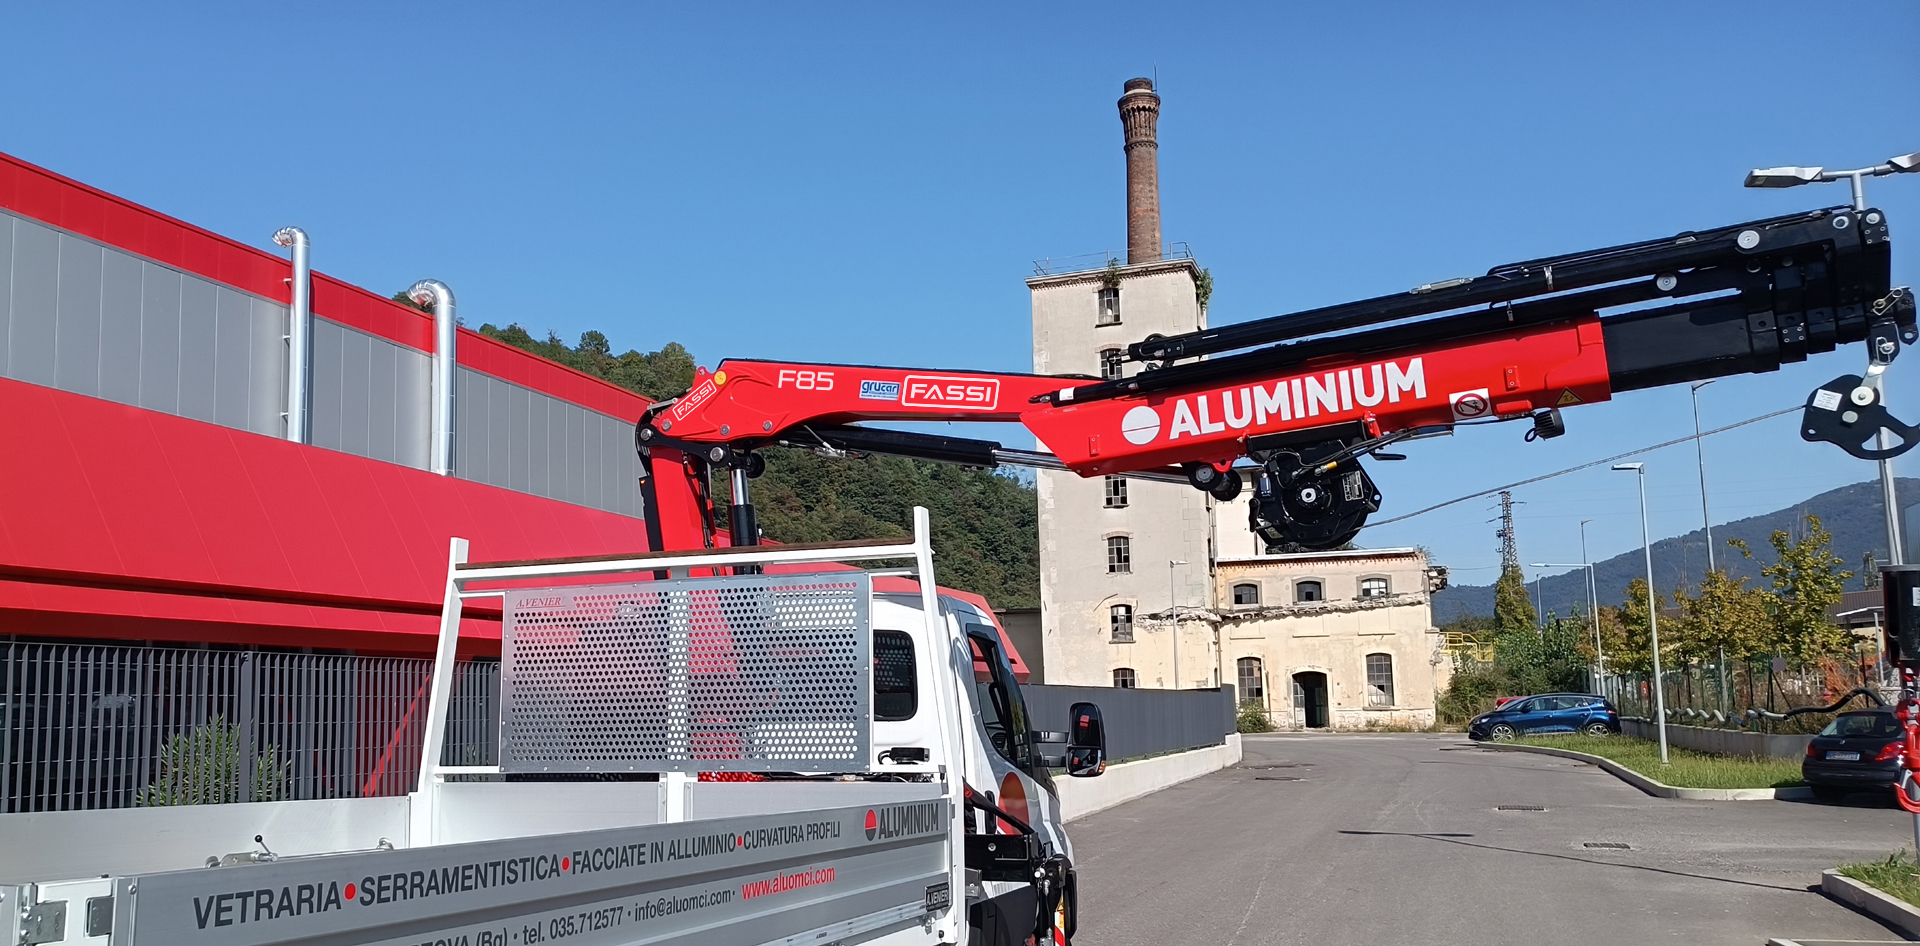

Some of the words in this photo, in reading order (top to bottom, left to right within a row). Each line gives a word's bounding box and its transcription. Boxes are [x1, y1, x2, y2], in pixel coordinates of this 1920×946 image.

[777, 369, 834, 391] F85
[861, 381, 897, 394] grucar
[910, 383, 992, 403] FASSI
[677, 384, 712, 416] FASSI
[1169, 356, 1427, 440] ALUMINIUM
[878, 802, 939, 840] ALUMINIUM
[193, 881, 342, 930] VETRARIA
[359, 854, 561, 907] SERRAMENTISTICA
[572, 842, 646, 875] FACCIATE
[650, 841, 664, 864] IN
[667, 832, 736, 862] ALLUMINIO
[743, 824, 804, 851] CURVATURA
[806, 821, 841, 842] PROFILI
[522, 921, 546, 946] tel.
[550, 905, 624, 940] 035.712577
[634, 889, 731, 922] info@aluomci.com
[741, 866, 835, 900] www.aluomci.com
